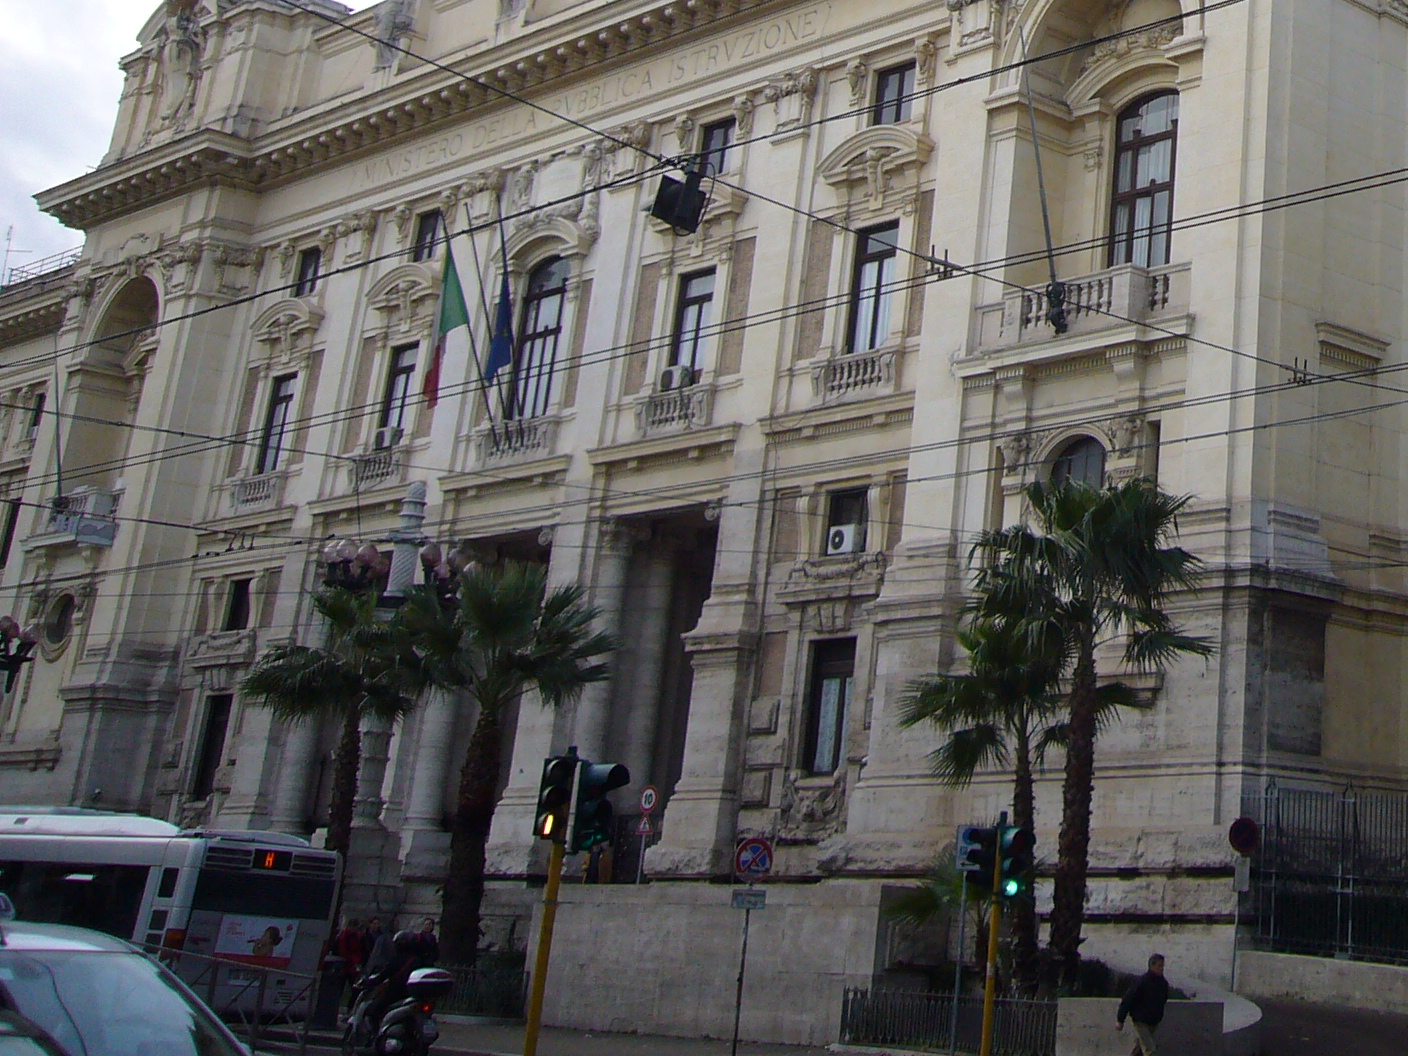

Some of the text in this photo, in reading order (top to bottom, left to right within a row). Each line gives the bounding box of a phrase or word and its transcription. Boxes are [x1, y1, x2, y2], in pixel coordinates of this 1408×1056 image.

[360, 133, 463, 187] MINISTERO
[472, 108, 539, 150] DELLA
[667, 9, 818, 84] ISTRVZIONE
[643, 793, 654, 805] 10
[264, 852, 276, 869] H
